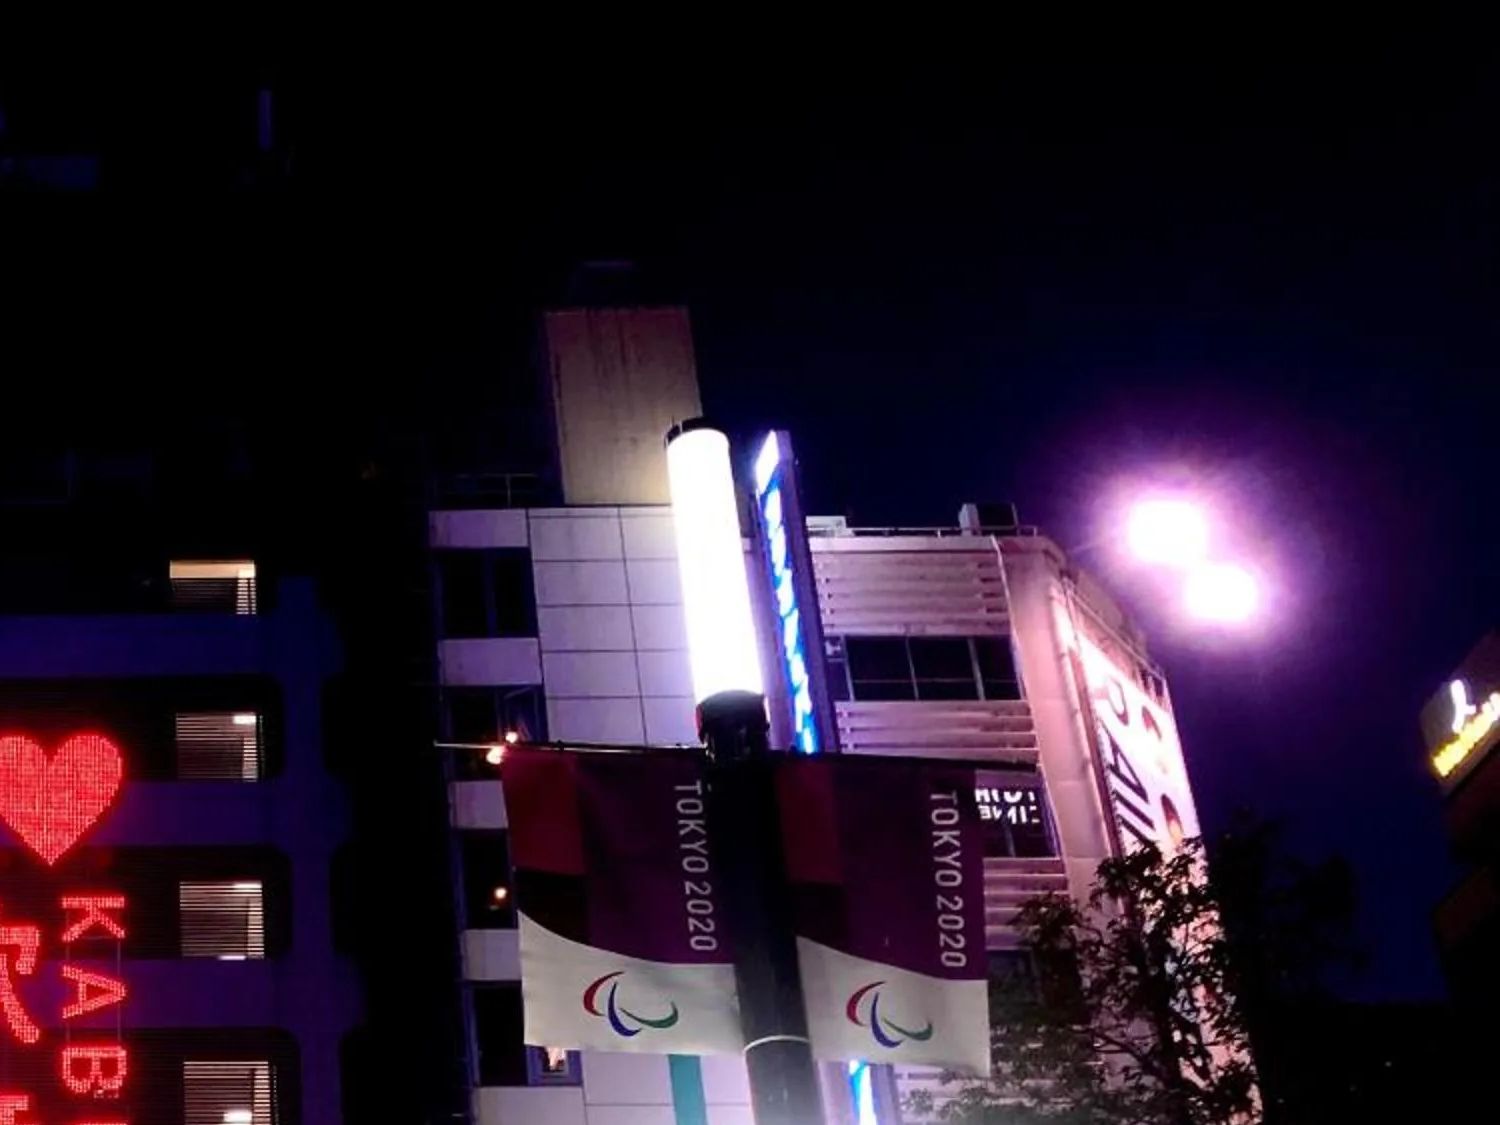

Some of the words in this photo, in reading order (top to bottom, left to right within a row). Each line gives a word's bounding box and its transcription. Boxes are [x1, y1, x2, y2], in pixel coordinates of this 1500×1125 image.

[674, 779, 710, 874] TOKYO
[930, 789, 963, 888] TOKYO
[684, 878, 718, 952] 2020
[936, 893, 968, 969] 2020
